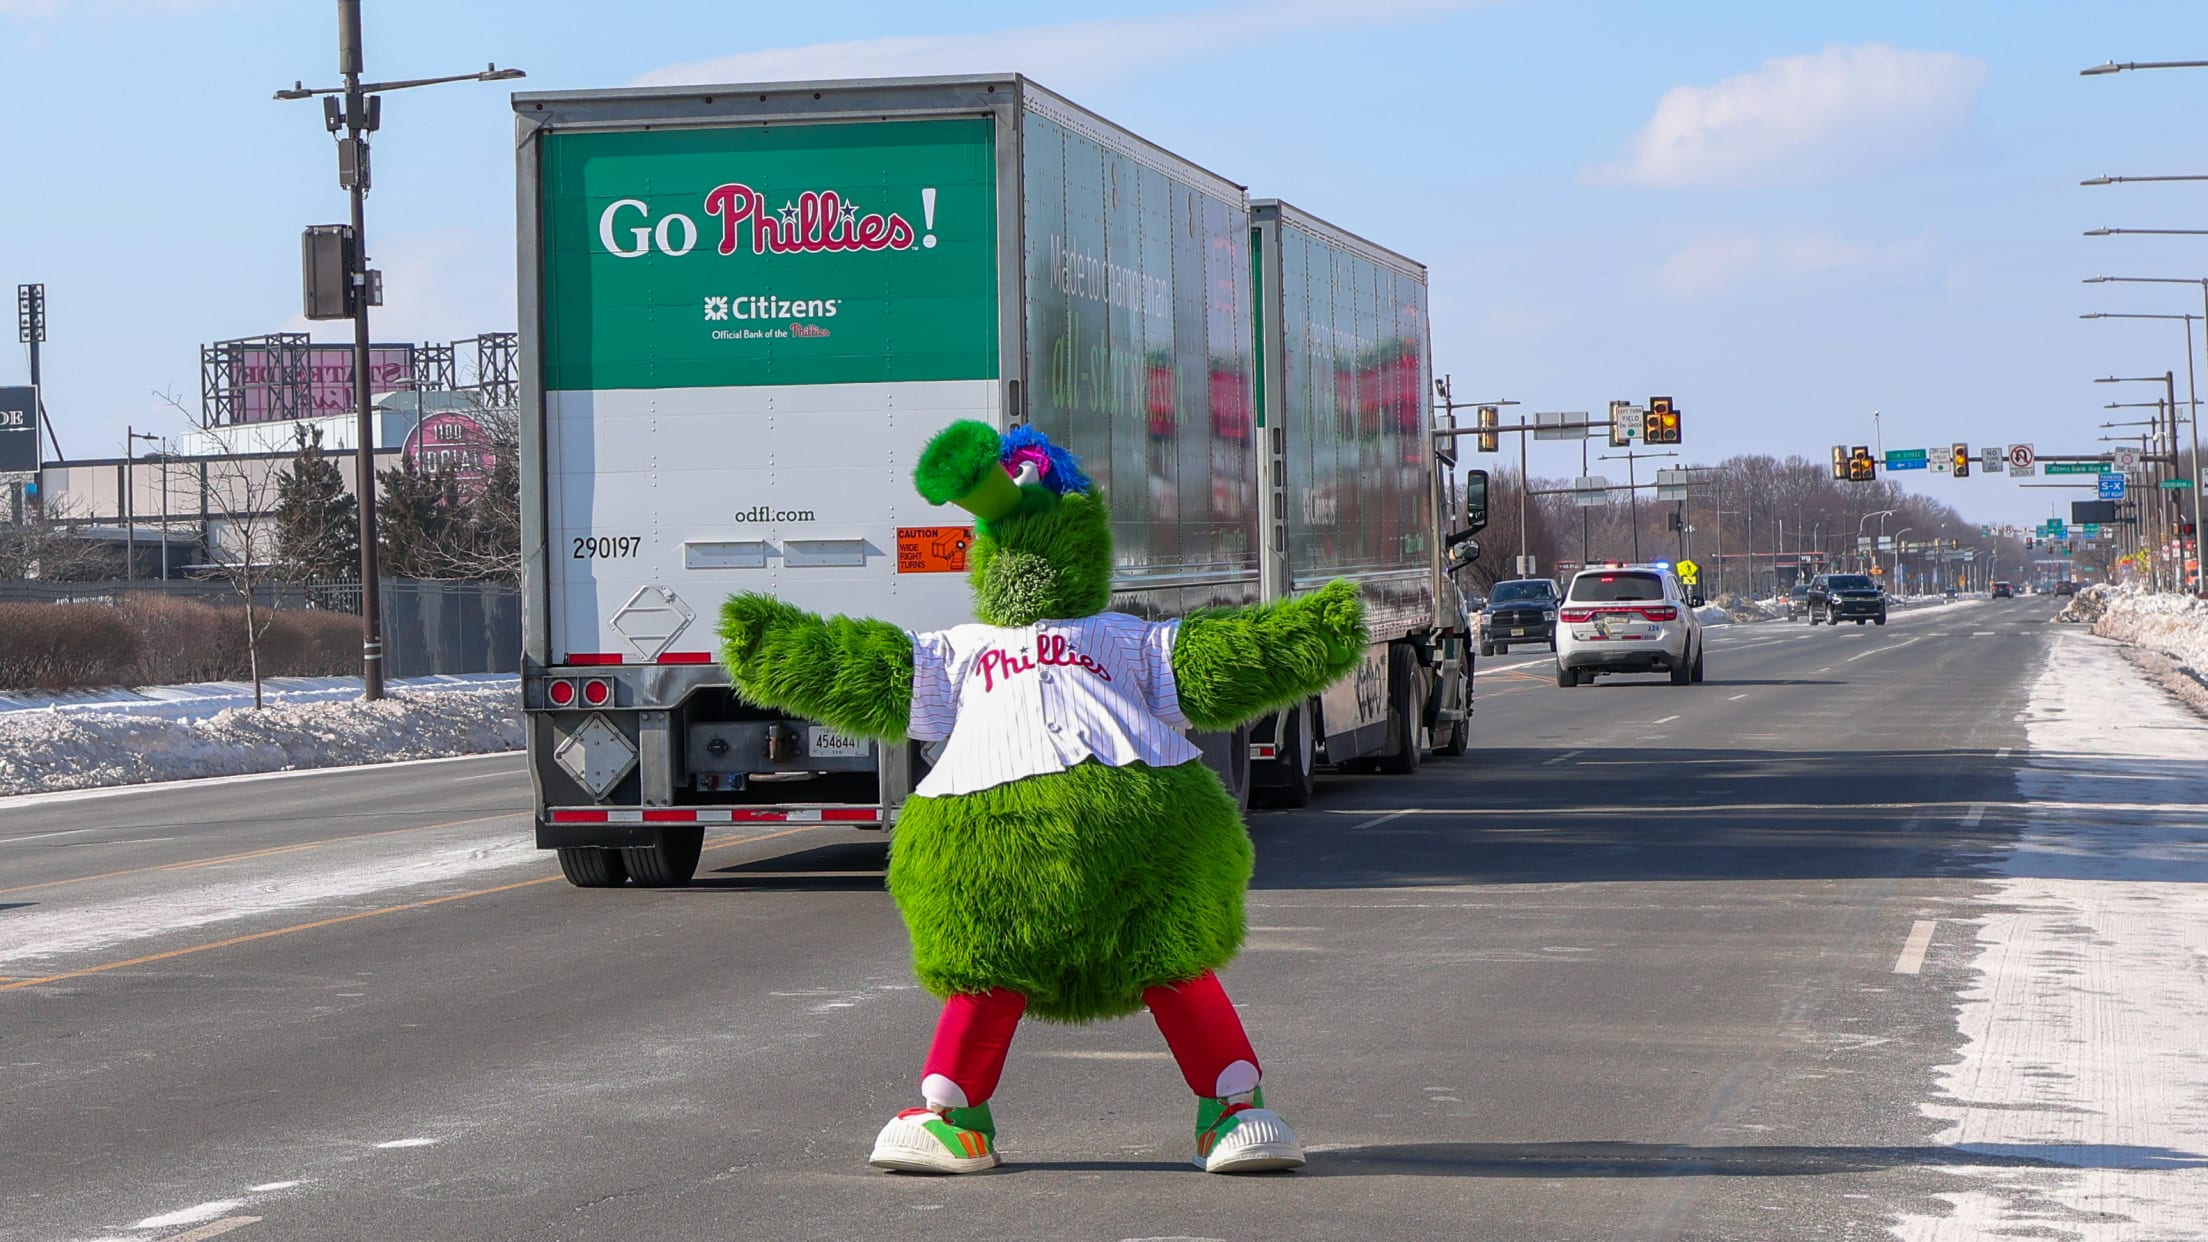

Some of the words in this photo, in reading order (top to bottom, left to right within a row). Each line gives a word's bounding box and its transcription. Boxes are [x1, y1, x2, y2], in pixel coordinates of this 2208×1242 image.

[599, 198, 698, 258] Go
[732, 296, 839, 319] Citizens
[712, 329, 742, 340] Official
[744, 329, 763, 338] Bank
[765, 329, 774, 338] of
[775, 329, 788, 338] the
[790, 323, 831, 338] Phillies
[433, 423, 462, 440] 1100
[2101, 482, 2121, 490] S-X
[735, 506, 816, 523] odfl.com
[898, 529, 939, 538] CAUTION
[573, 536, 642, 559] 290197
[900, 543, 919, 552] WIDE
[900, 552, 922, 560] RIGHT
[900, 560, 926, 569] TURNS
[975, 634, 1112, 693] Phillies
